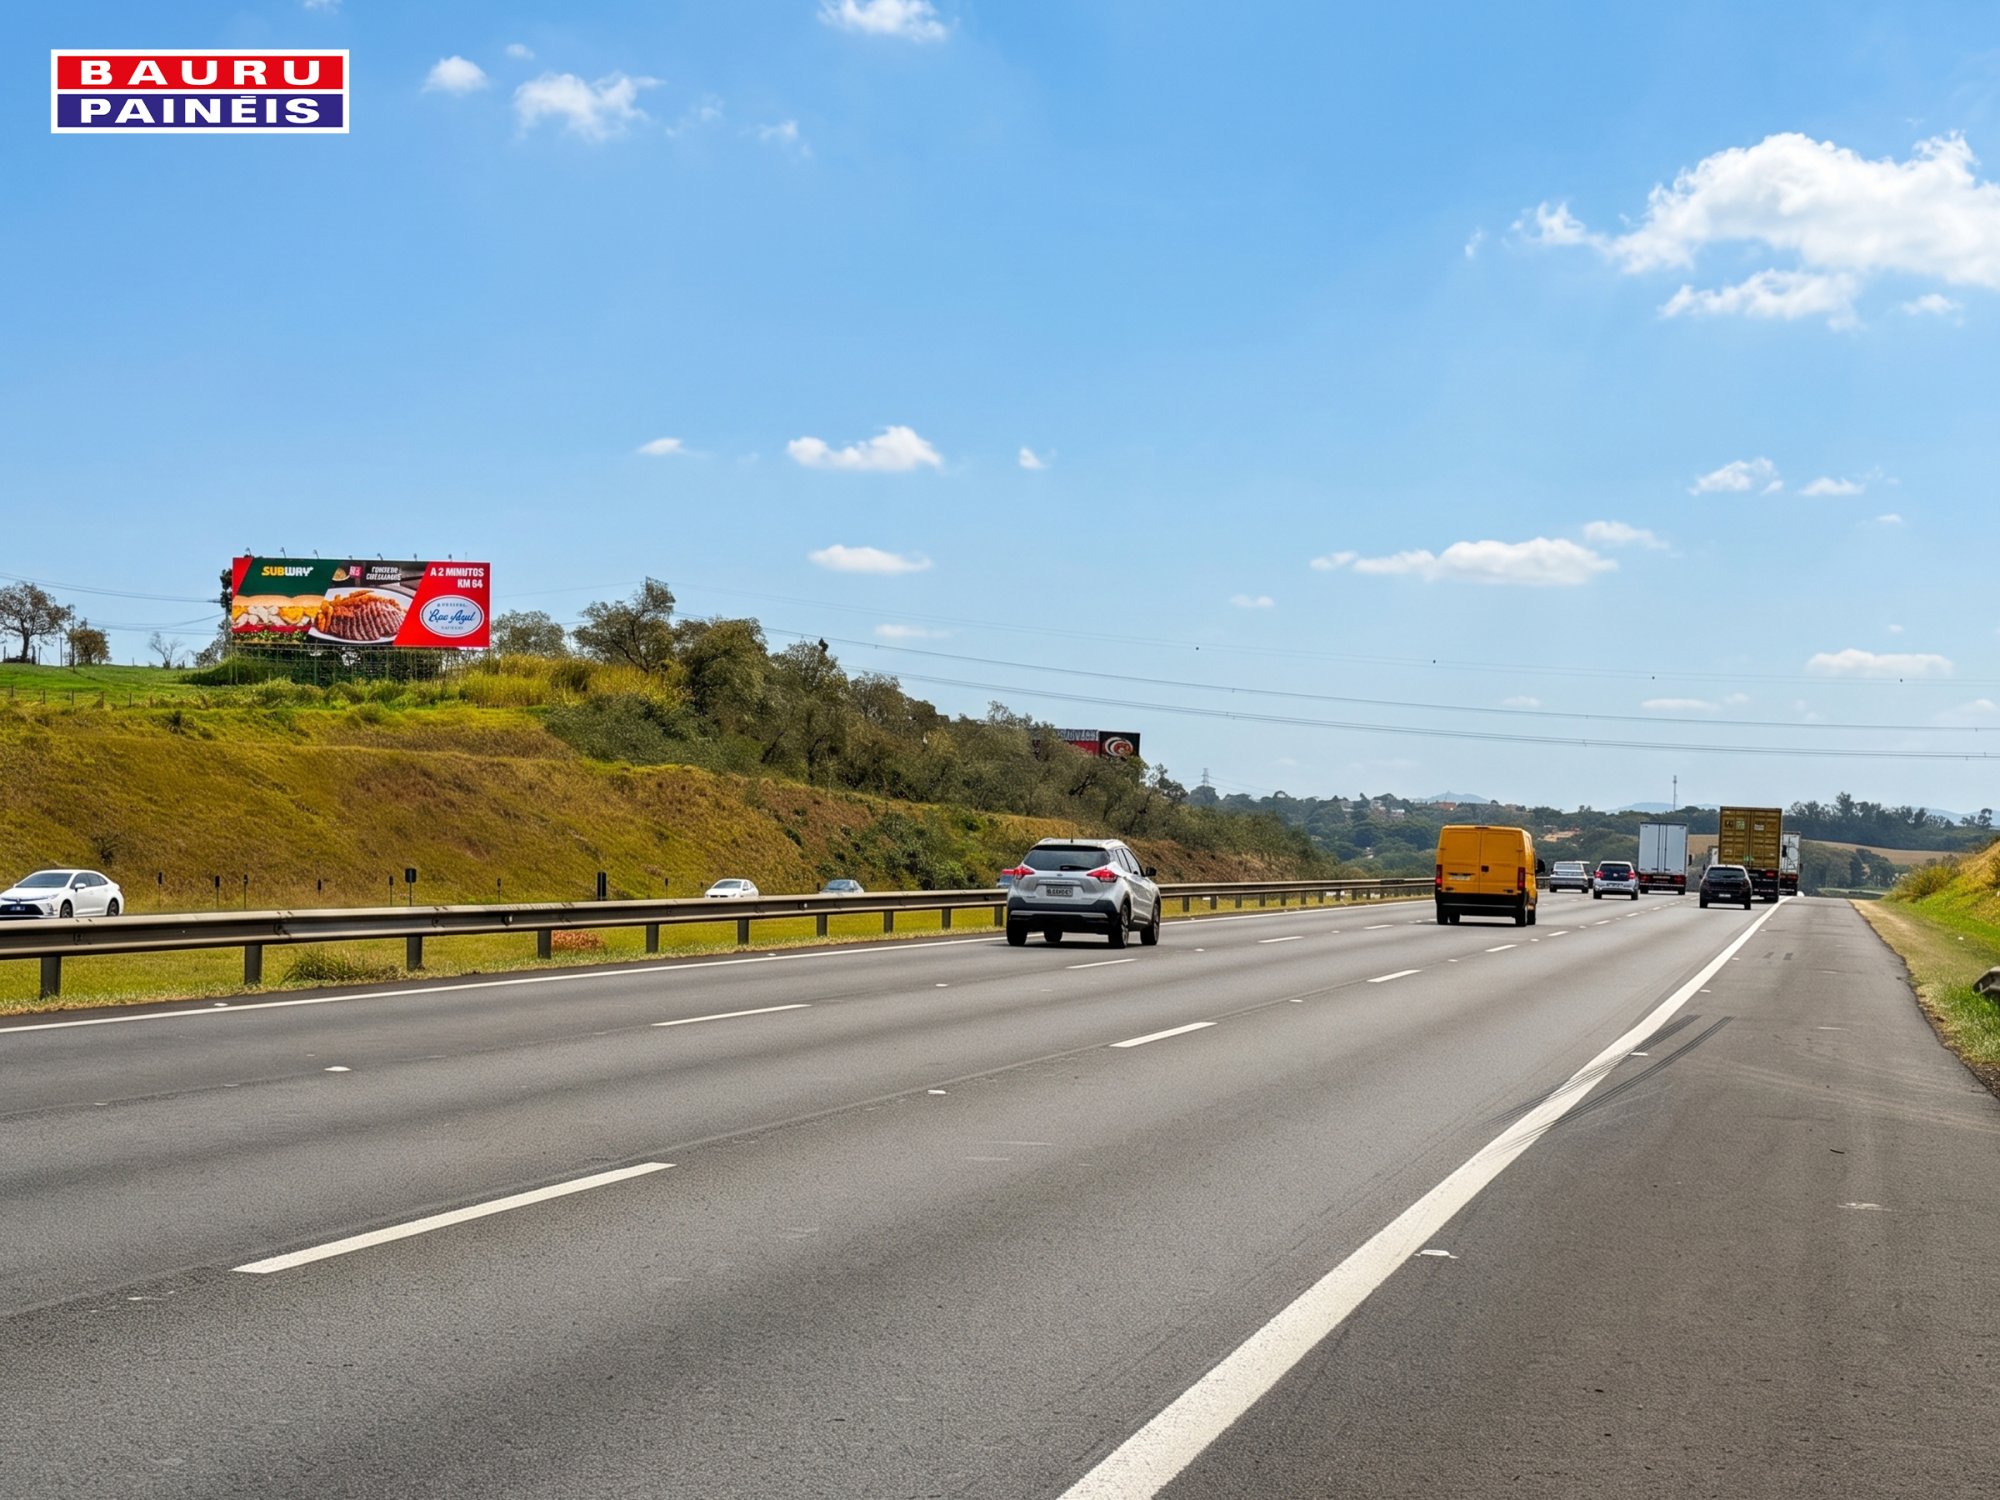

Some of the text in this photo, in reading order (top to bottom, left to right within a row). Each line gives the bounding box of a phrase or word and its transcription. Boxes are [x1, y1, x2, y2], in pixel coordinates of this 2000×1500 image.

[261, 566, 314, 577] SUBWAY
[430, 567, 485, 577] A 2 MINUTOS
[457, 578, 483, 589] KM 64
